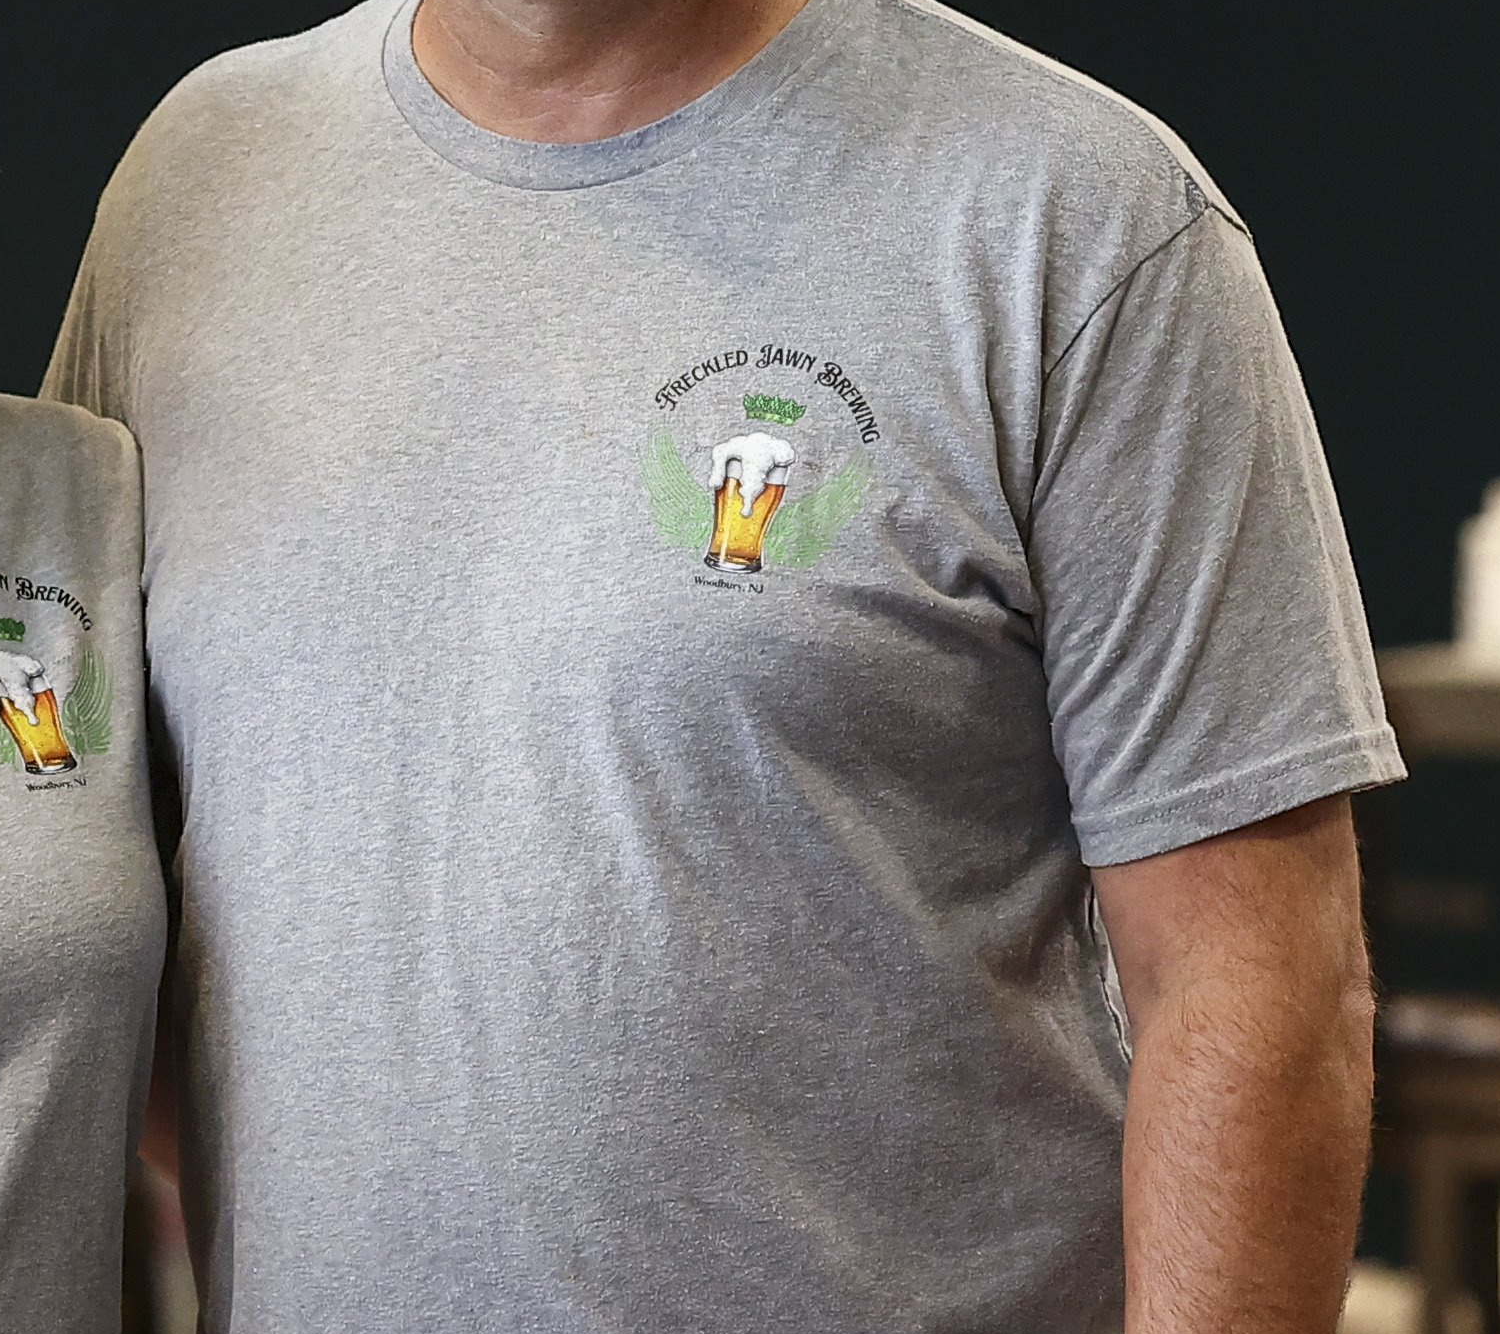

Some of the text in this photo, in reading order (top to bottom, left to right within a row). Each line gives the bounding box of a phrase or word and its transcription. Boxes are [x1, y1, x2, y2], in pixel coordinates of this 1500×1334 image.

[655, 350, 748, 411] FRECKLED
[814, 362, 881, 445] BREWING
[15, 576, 93, 631] BREWING
